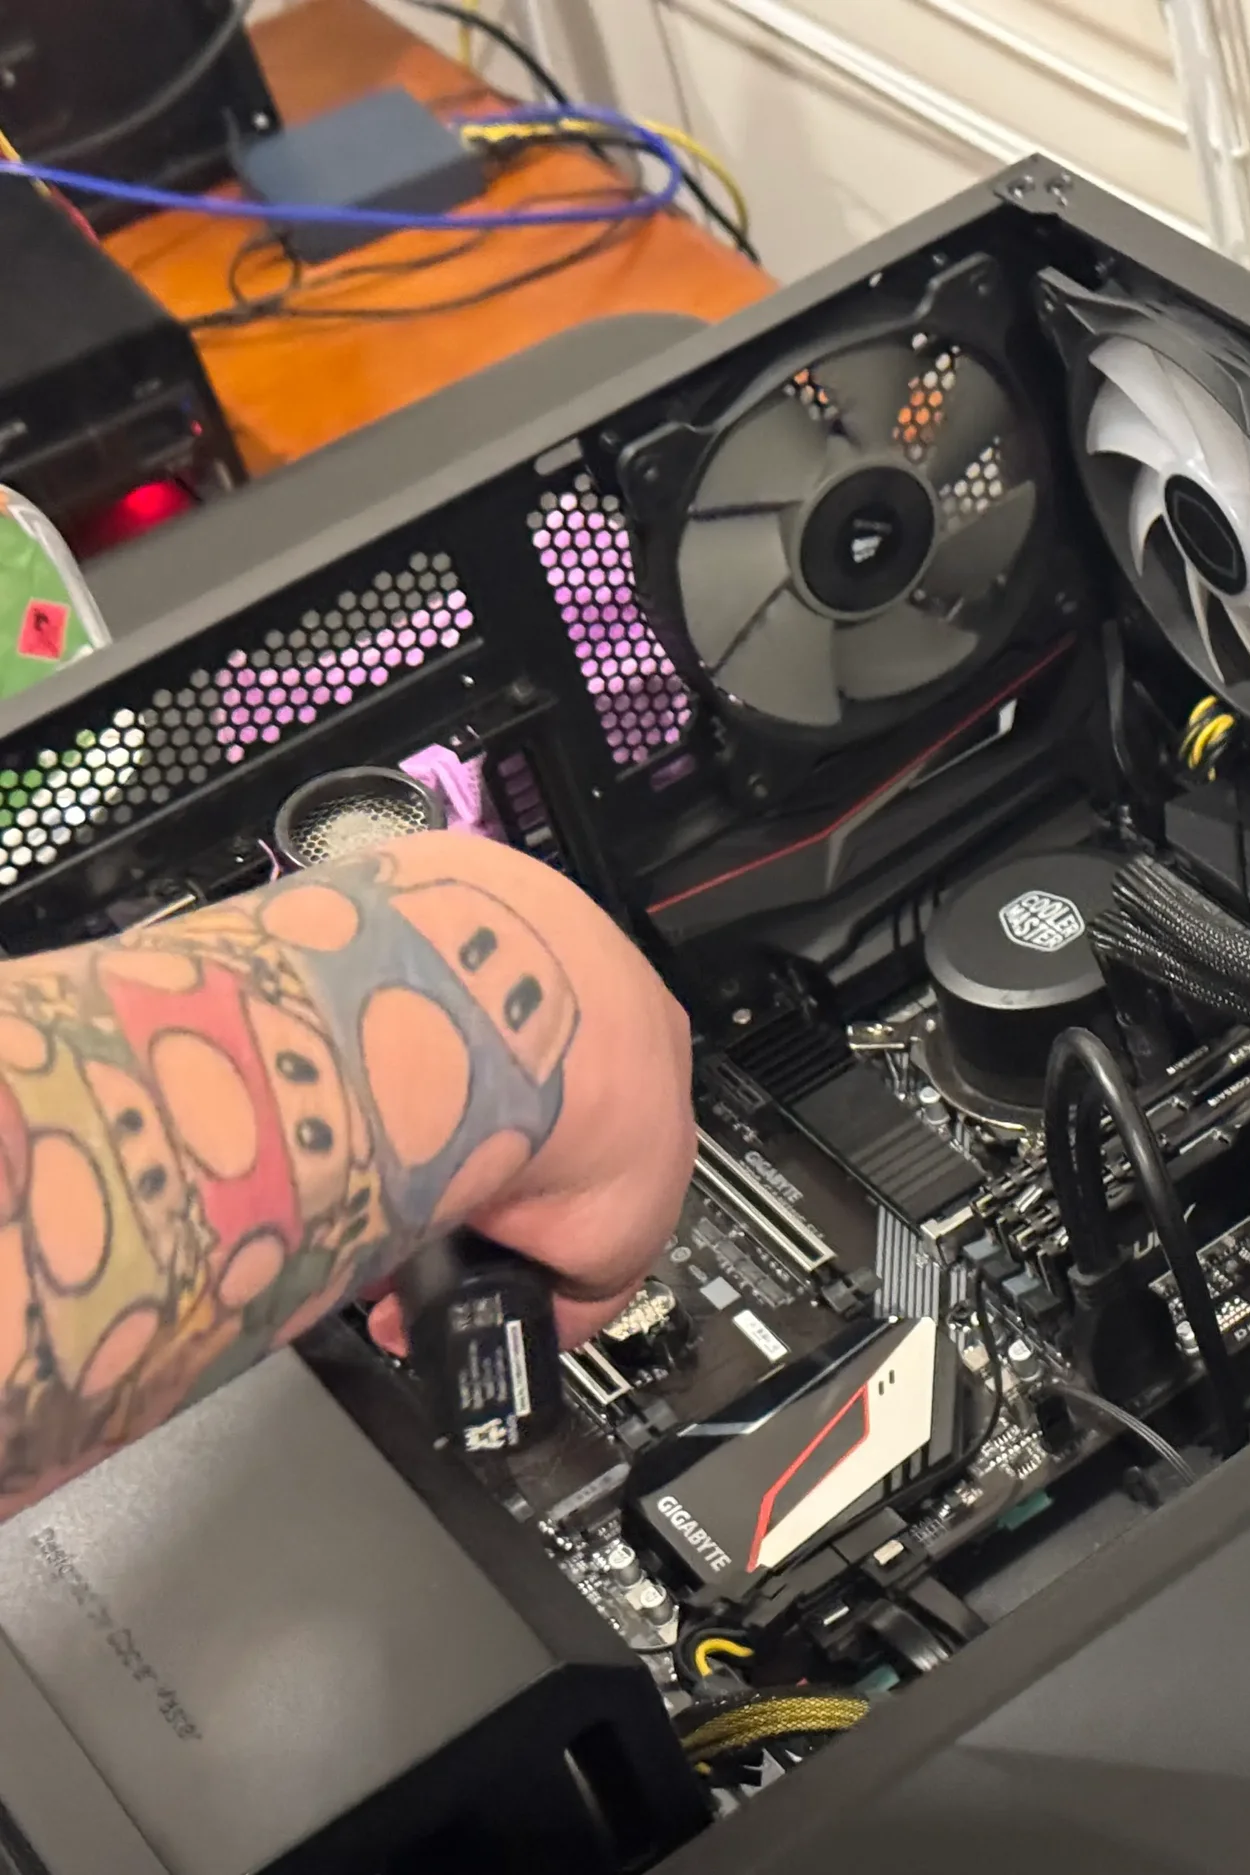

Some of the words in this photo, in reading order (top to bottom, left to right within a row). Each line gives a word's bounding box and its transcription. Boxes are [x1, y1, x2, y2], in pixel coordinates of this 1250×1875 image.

[1005, 904, 1064, 948] MASTER
[1021, 894, 1079, 938] COOLER
[744, 1151, 803, 1204] GIGABYTE
[656, 1494, 732, 1573] GIGABYTE
